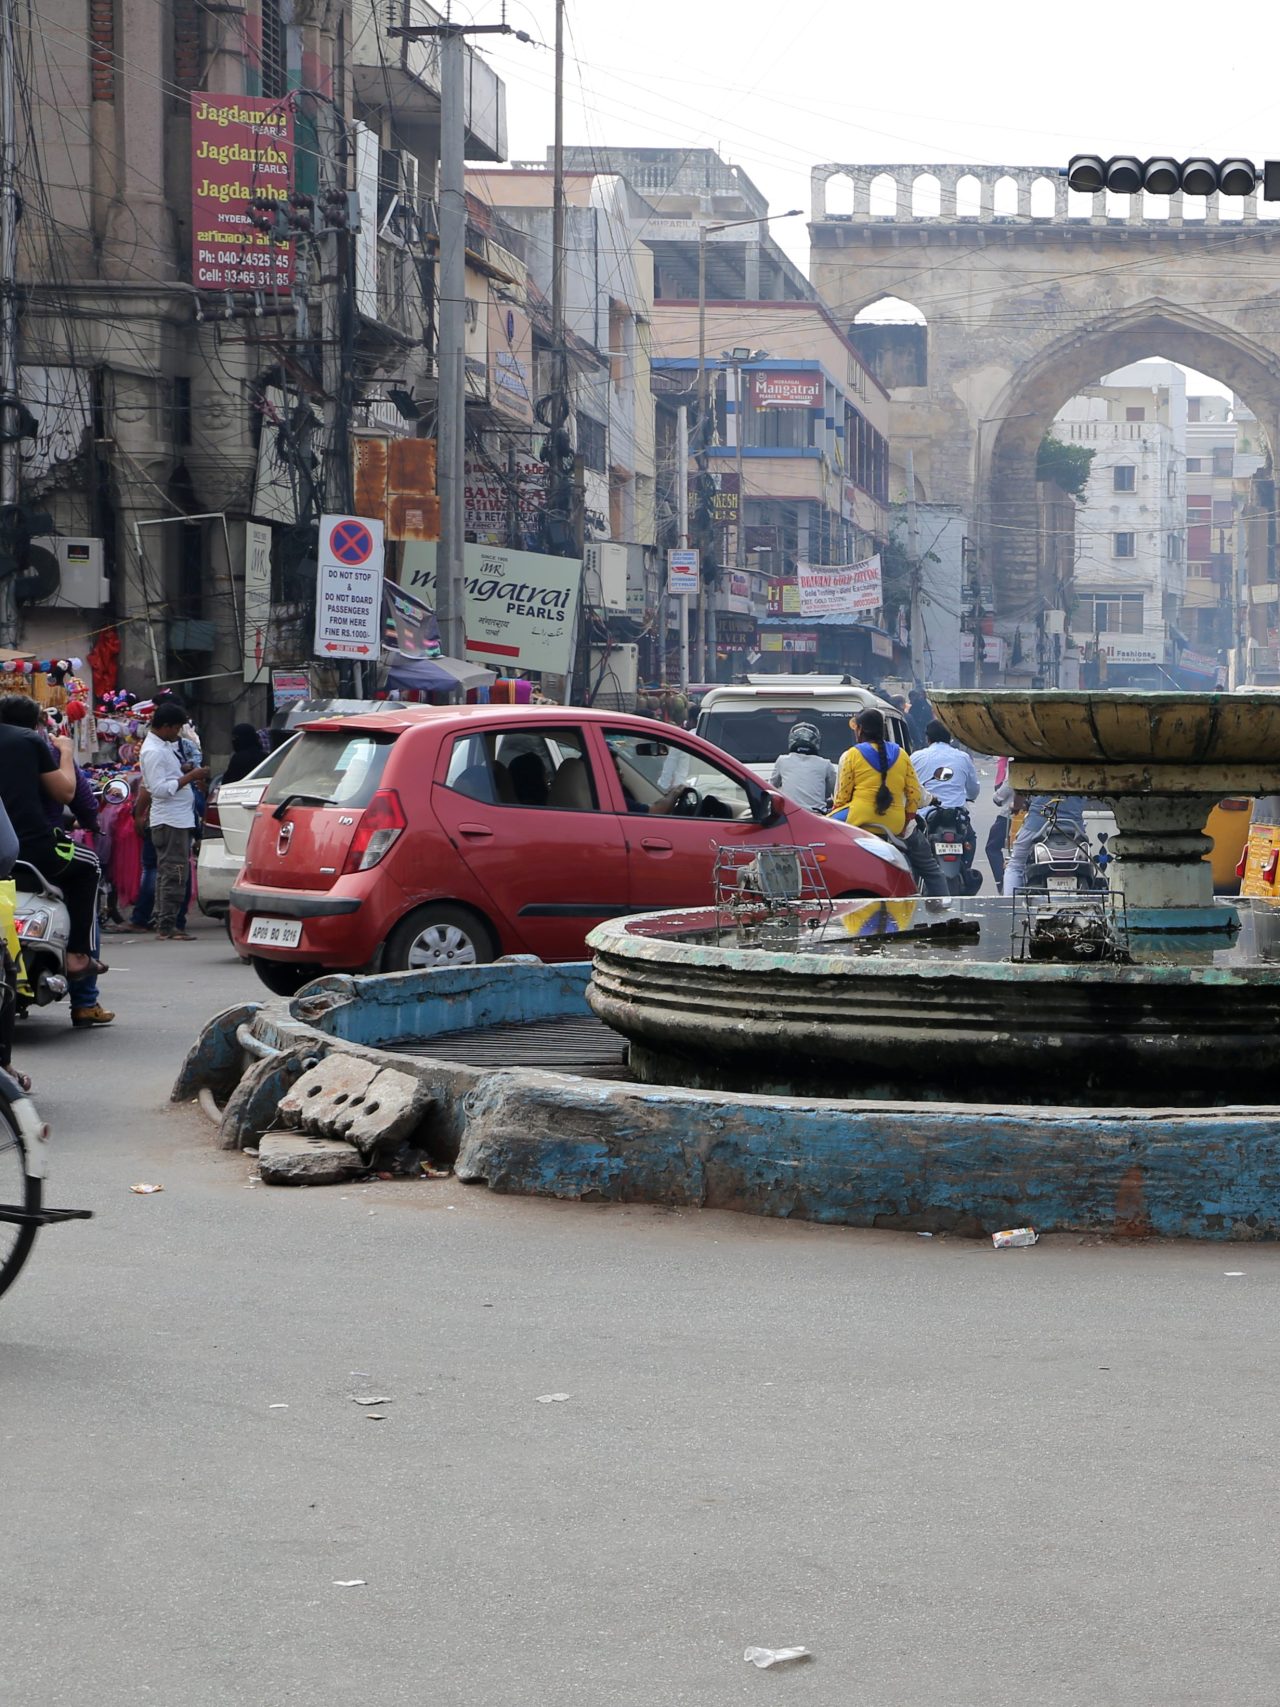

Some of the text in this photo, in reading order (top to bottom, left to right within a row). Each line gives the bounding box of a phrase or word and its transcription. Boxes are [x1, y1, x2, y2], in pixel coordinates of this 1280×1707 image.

[196, 140, 288, 165] Jagdamba
[252, 163, 288, 174] PEARLS
[198, 250, 215, 263] Ph:
[198, 268, 222, 281] Cell:
[755, 381, 819, 396] Mangatrai
[328, 570, 372, 581] DO NOT STOP
[346, 583, 352, 591] &
[410, 569, 572, 609] mngatrai
[325, 593, 374, 604] DO NOT BOARD
[327, 604, 370, 616] PASSENGERS
[506, 602, 566, 622] PEARLS
[329, 616, 367, 627] FROM HERE
[325, 628, 340, 636] FINE
